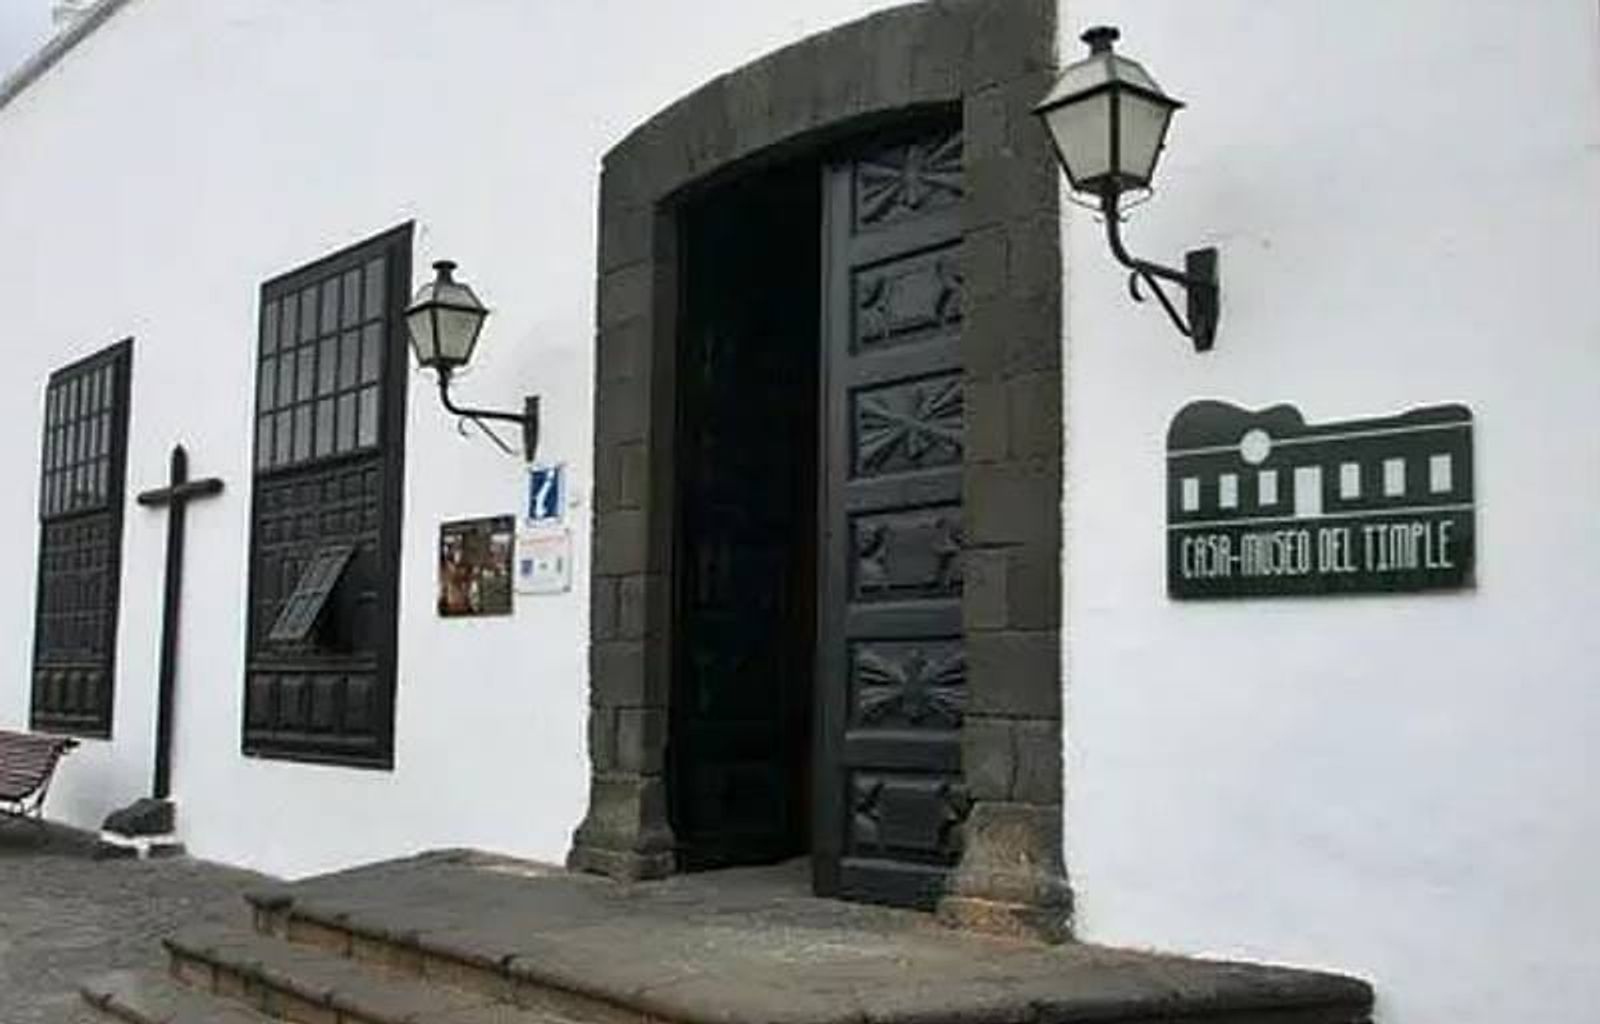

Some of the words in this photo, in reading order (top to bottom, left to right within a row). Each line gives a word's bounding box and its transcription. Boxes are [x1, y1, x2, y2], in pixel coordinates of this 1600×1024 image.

[1182, 531, 1311, 578] CASA-MUSEO
[1318, 527, 1357, 573] DEL
[1364, 521, 1454, 571] TIMPLE
